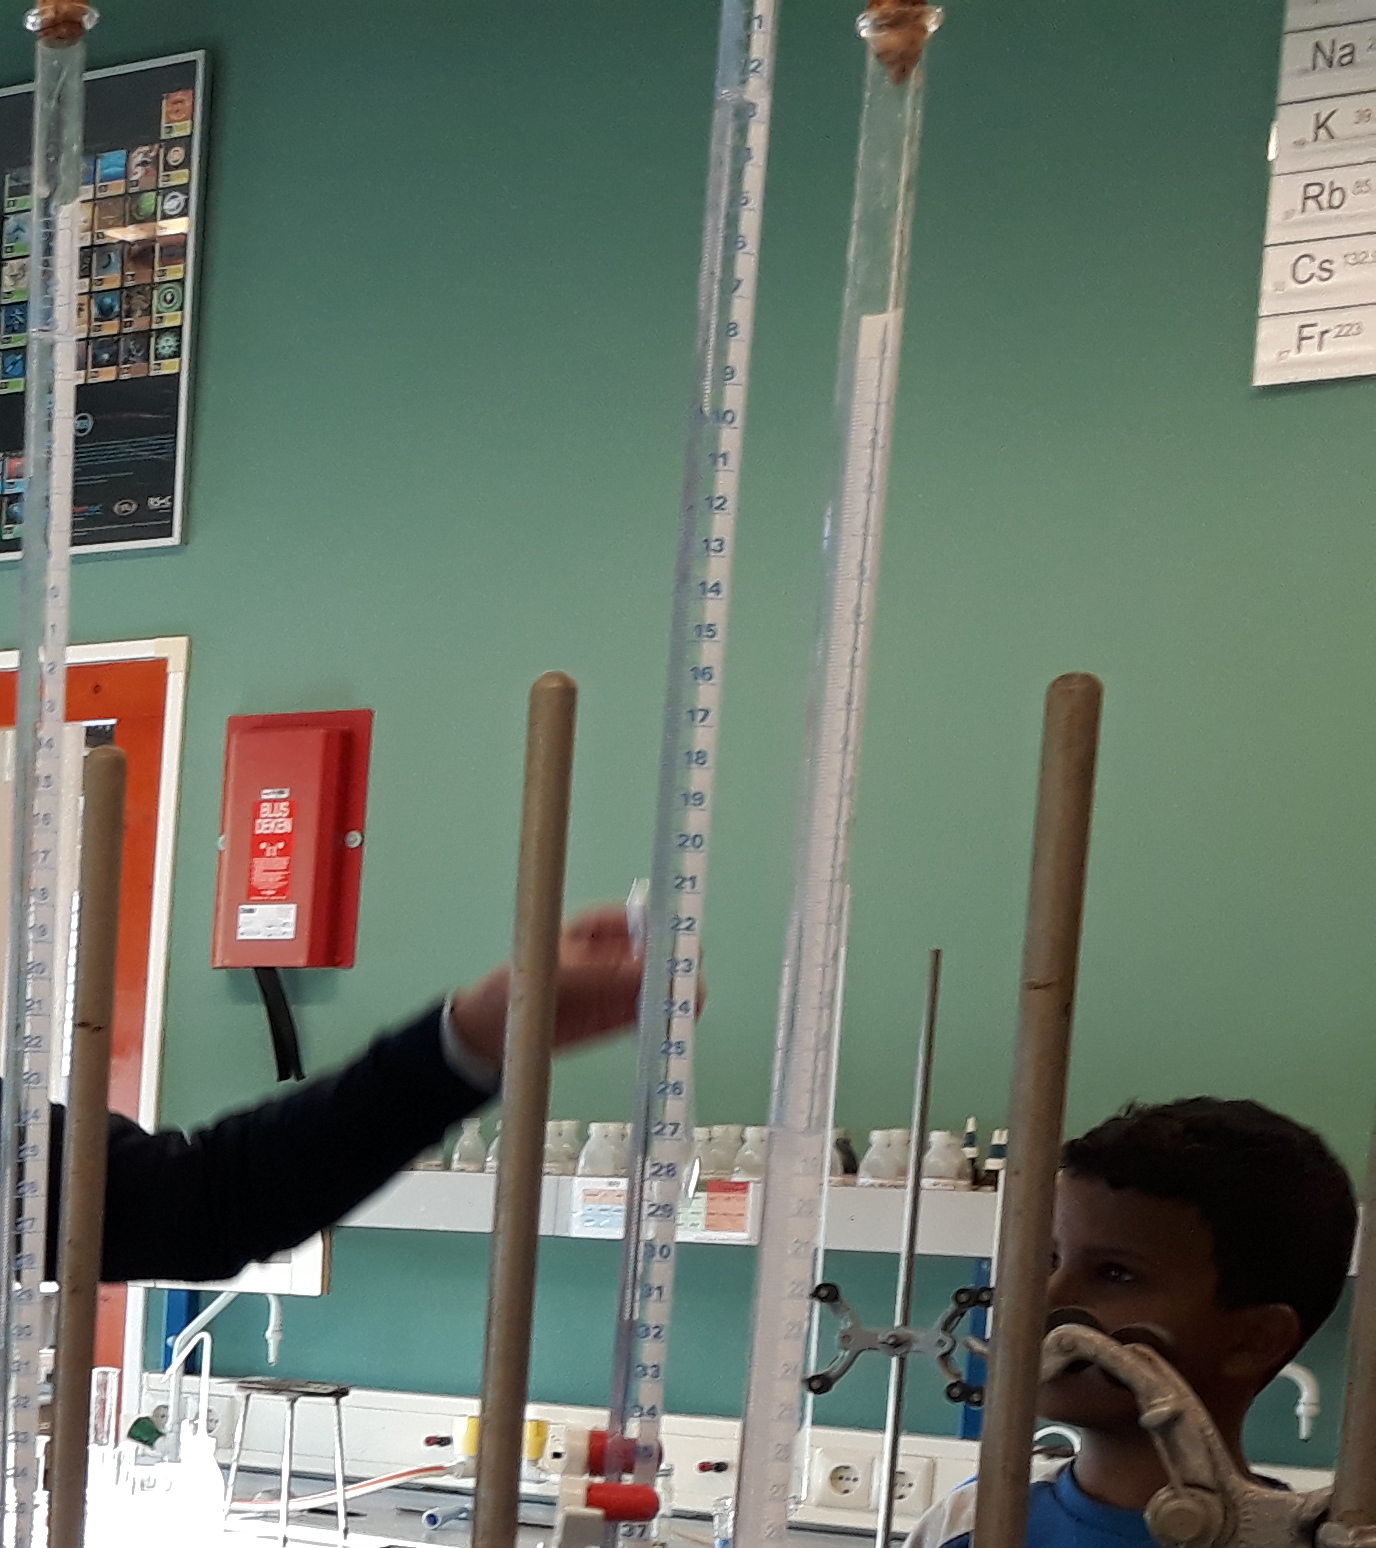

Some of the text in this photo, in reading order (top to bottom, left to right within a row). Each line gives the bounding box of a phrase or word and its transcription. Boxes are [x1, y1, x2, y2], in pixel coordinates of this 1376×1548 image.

[1312, 38, 1356, 71] Na
[1311, 107, 1340, 143] K
[1301, 180, 1346, 214] Rb
[1291, 253, 1335, 285] Cs
[731, 277, 745, 295] 7
[726, 321, 739, 338] 8
[1297, 322, 1331, 354] Fr
[722, 365, 736, 382] 9
[711, 408, 735, 425] 10
[708, 452, 730, 467] 11
[704, 495, 728, 511] 12
[702, 537, 726, 554] 13
[698, 580, 722, 596] 14
[694, 623, 717, 639] 15
[689, 665, 714, 682] 16
[686, 708, 710, 724] 17
[684, 750, 707, 766] 18
[680, 791, 705, 808] 19
[676, 833, 704, 849] 20
[673, 874, 698, 890] 21
[670, 916, 698, 932] 22
[656, 1081, 685, 1097] 26
[651, 1120, 682, 1137] 27
[649, 1162, 678, 1179] 28
[647, 1203, 675, 1219] 29
